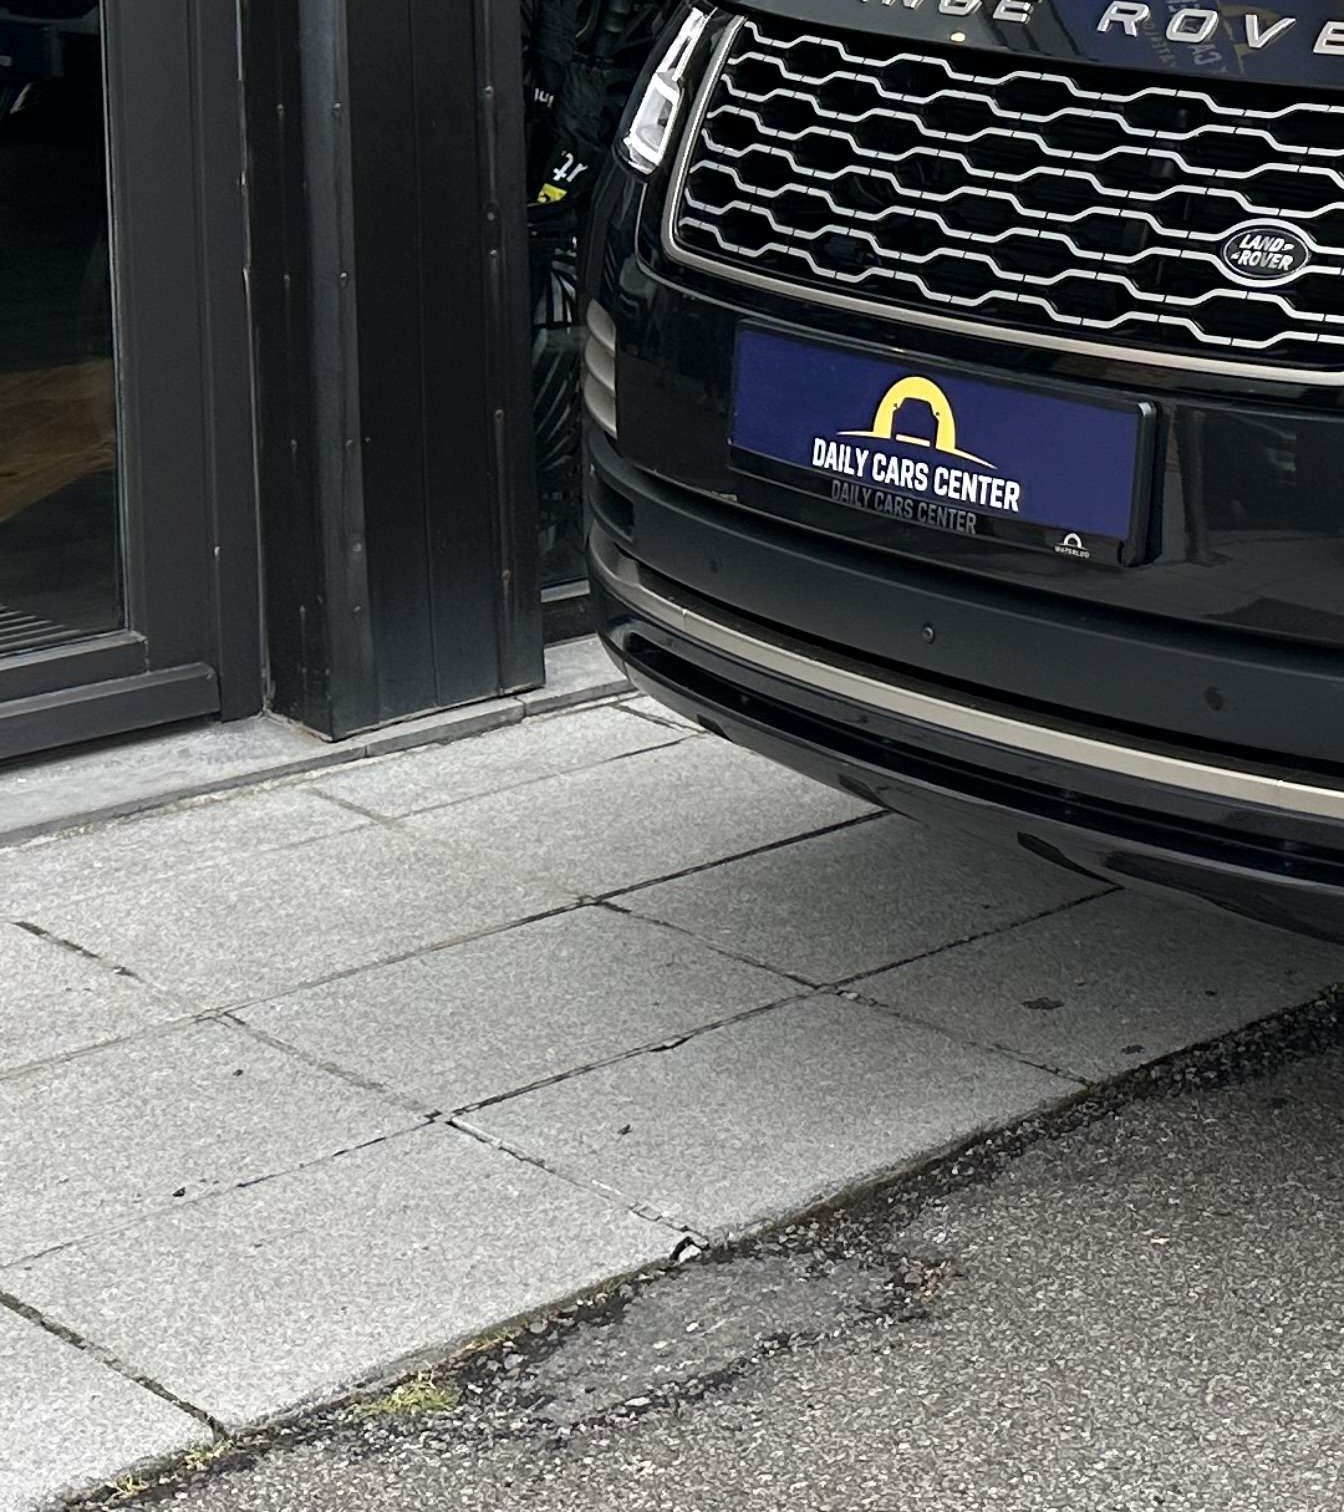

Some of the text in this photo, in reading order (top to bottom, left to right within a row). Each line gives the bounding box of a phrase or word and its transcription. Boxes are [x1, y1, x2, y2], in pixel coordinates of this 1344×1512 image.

[1239, 250, 1293, 270] ROVER
[1240, 235, 1285, 251] LAND
[812, 438, 1020, 512] DAILY CARS CENTER
[831, 479, 977, 535] DAILY CARS CENTER
